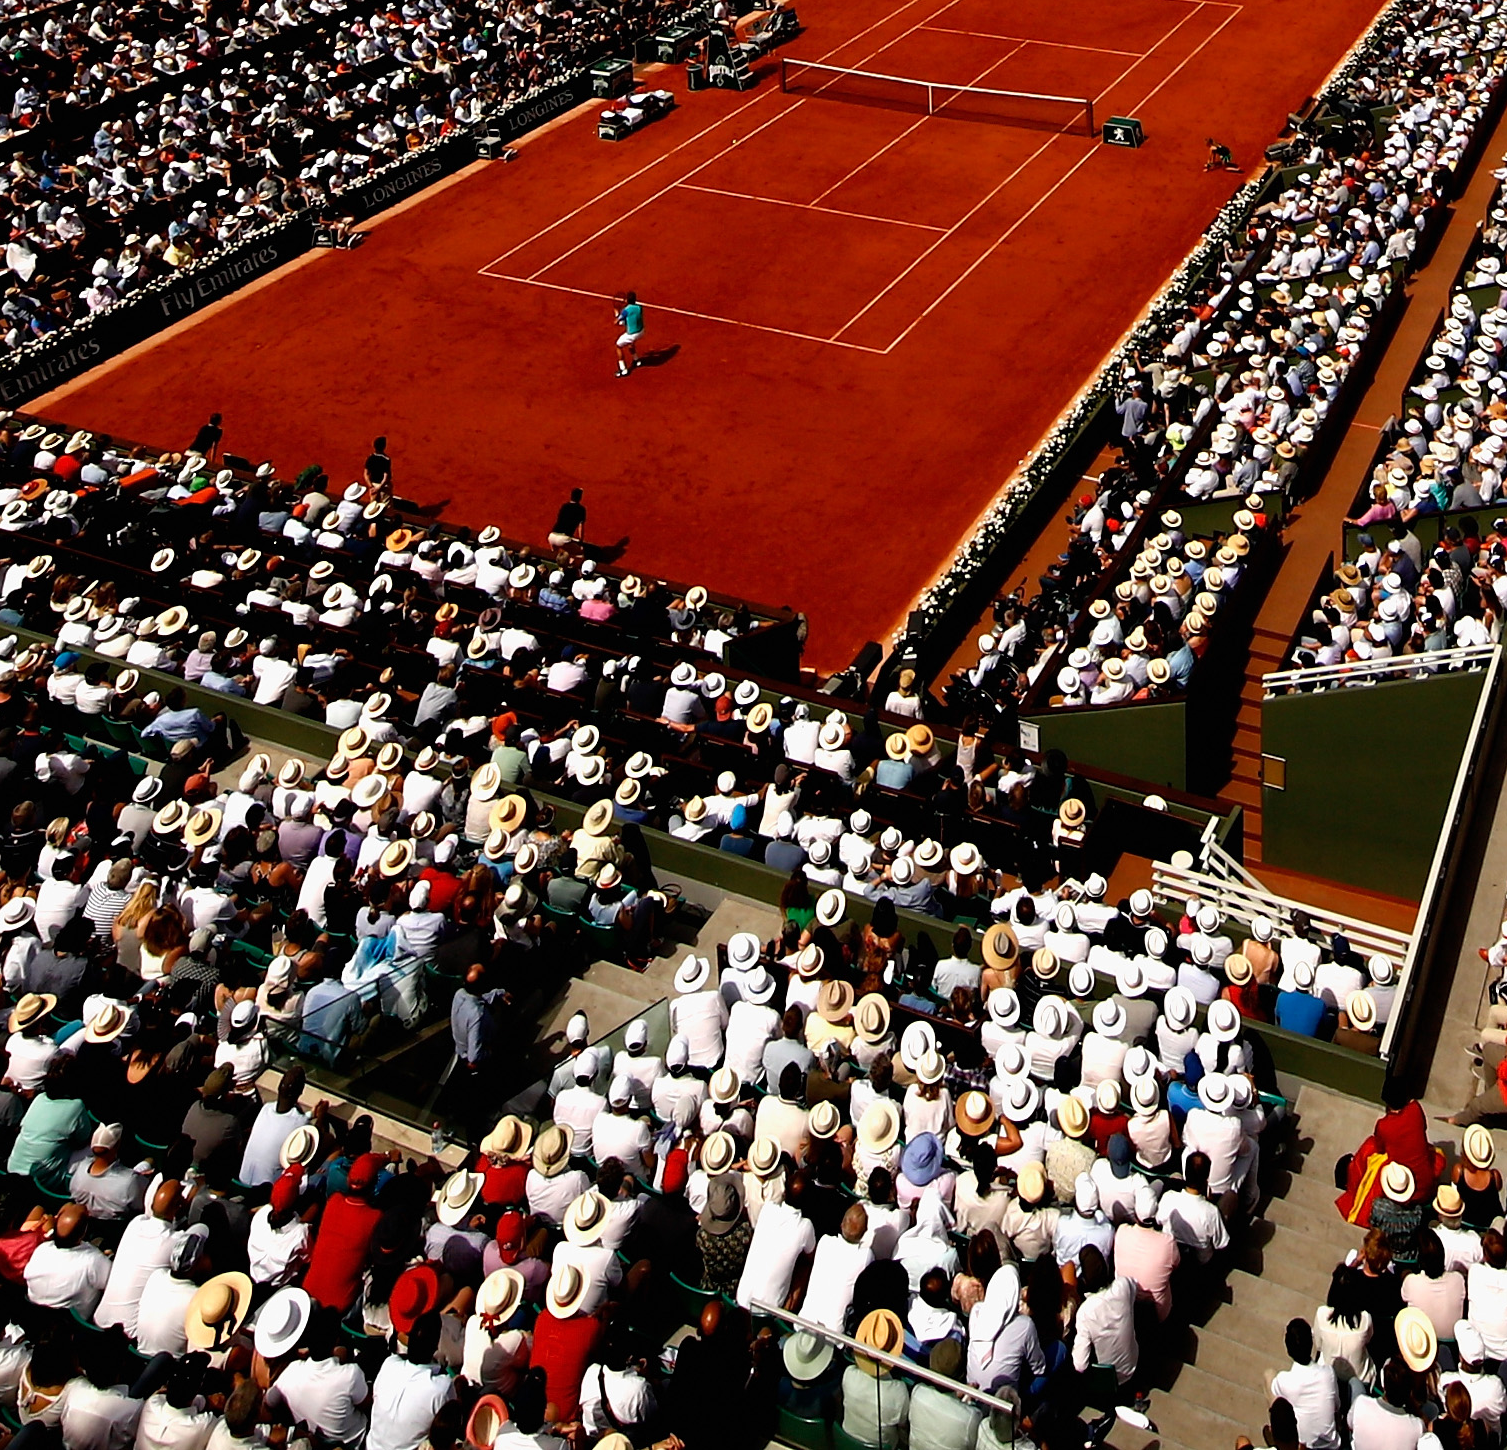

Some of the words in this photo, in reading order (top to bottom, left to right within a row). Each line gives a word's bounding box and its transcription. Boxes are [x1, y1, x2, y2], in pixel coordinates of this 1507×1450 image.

[508, 89, 574, 131] LONGINES
[362, 157, 443, 209] LONGINES
[159, 286, 198, 317] Fly
[198, 242, 278, 298] Emirates
